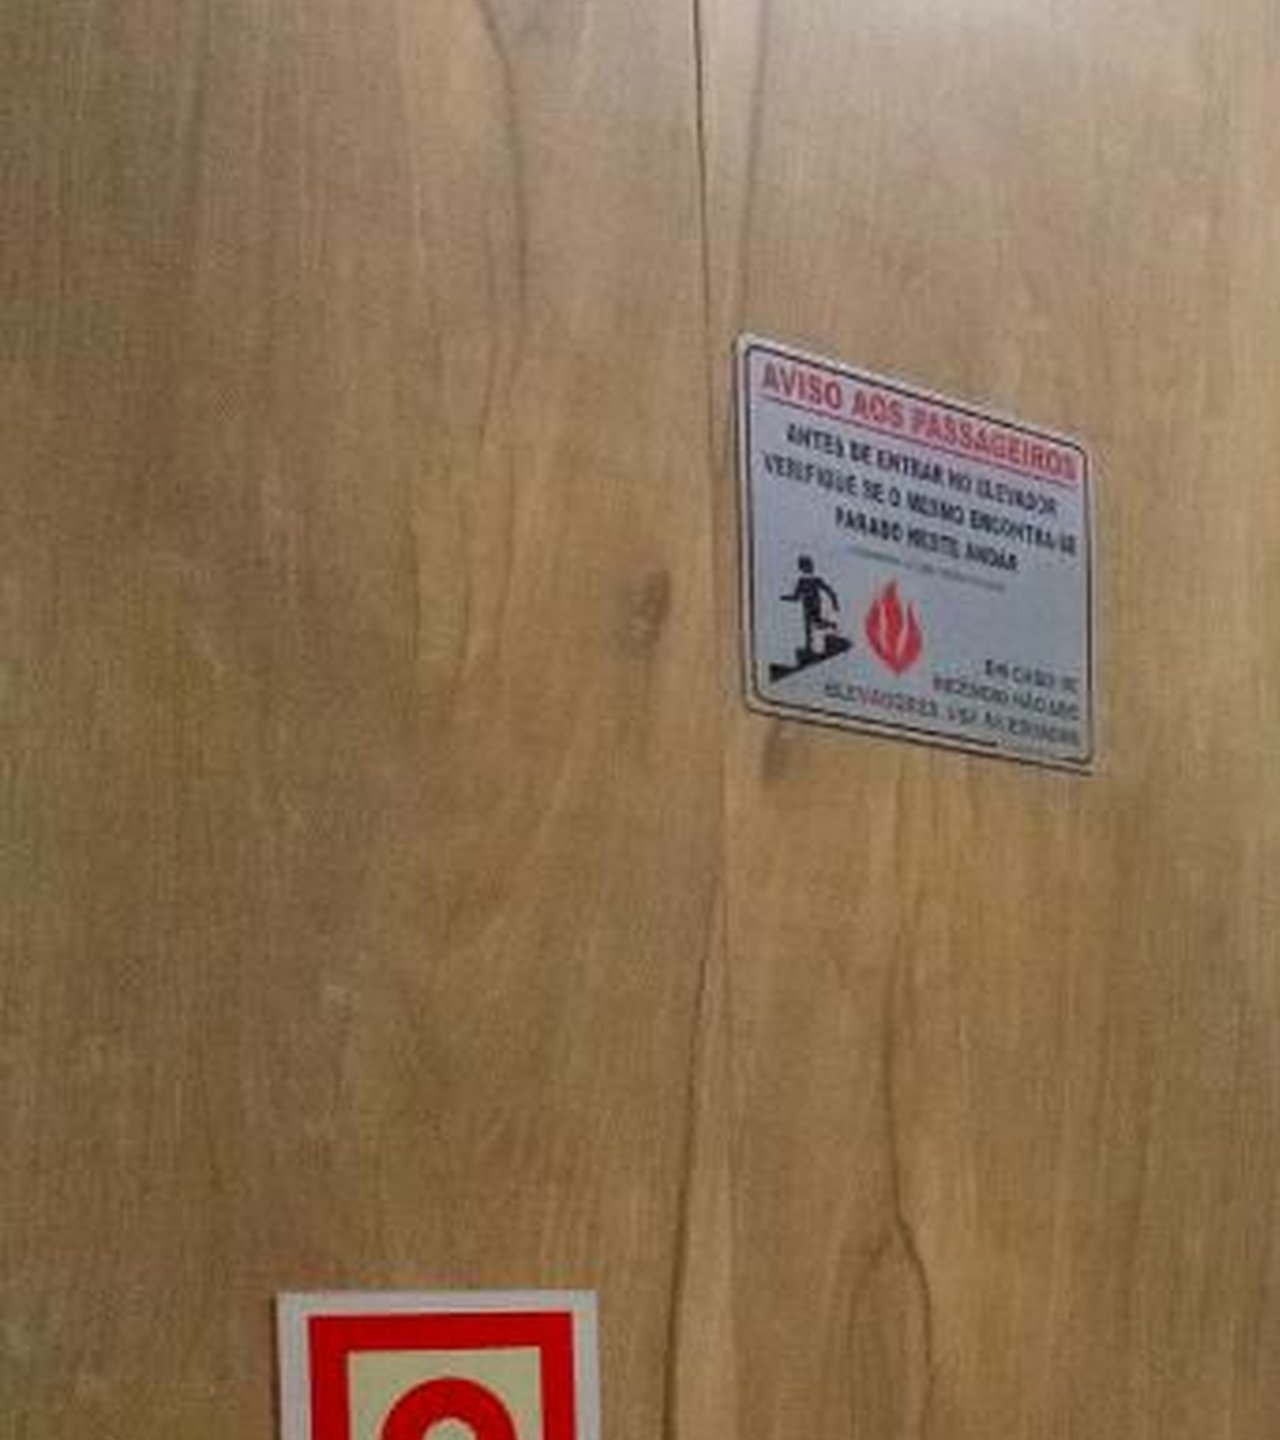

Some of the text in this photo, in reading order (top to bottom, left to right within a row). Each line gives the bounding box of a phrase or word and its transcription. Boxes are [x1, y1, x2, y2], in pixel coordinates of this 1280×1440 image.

[762, 362, 1079, 482] AVISO AOS PASSAGEIROS
[760, 450, 858, 499] VERIFIQUE
[862, 478, 885, 506] SE
[888, 486, 901, 508] O
[906, 490, 966, 527] MESMO
[786, 423, 1059, 517] ANTES DE ENTRAR NO ELEVADOR
[834, 506, 904, 545] PARADO
[907, 526, 960, 560] NESTE
[966, 541, 1018, 573] ANDAR
